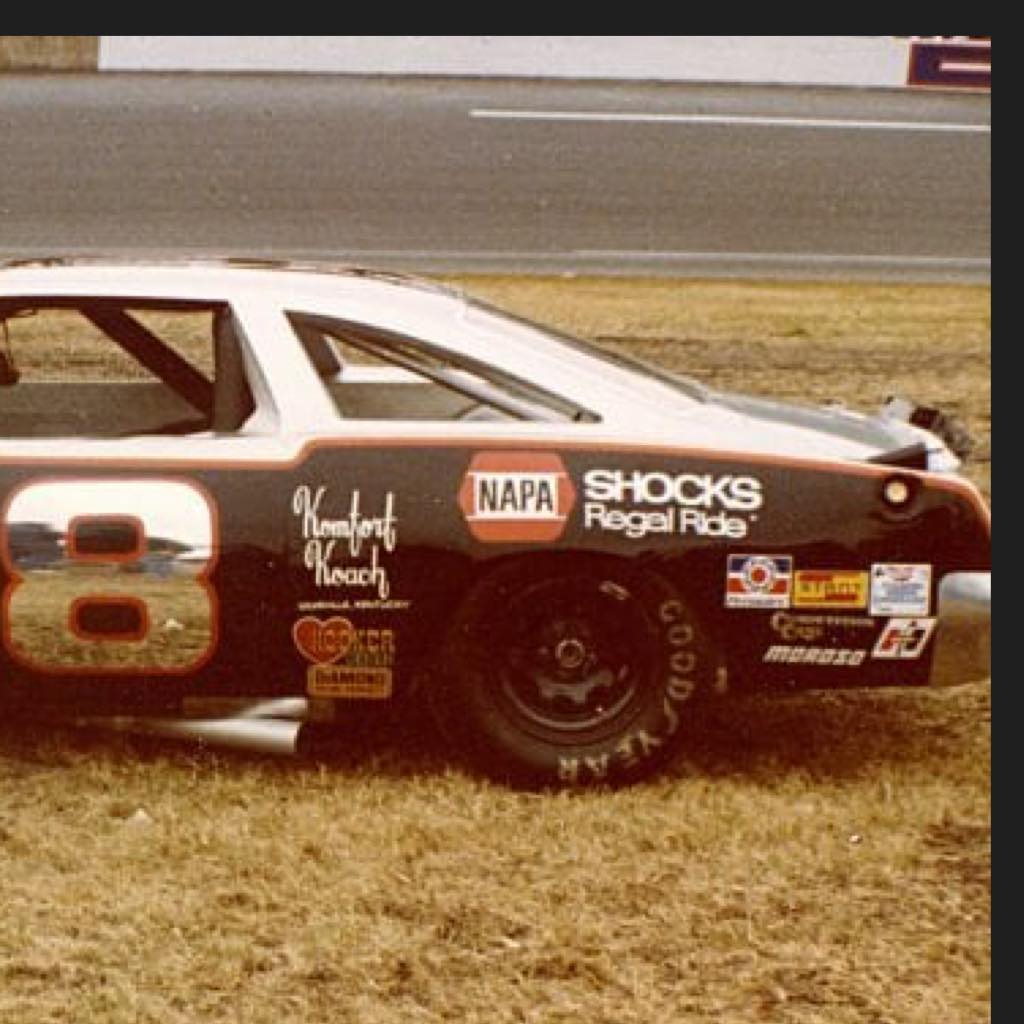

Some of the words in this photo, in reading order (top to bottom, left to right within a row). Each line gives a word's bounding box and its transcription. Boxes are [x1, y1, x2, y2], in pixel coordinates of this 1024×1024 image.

[479, 479, 554, 513] NAPA
[584, 469, 763, 512] SHOCKS
[293, 485, 398, 557] Komfort
[584, 502, 674, 539] Regal
[680, 508, 748, 539] Ride
[305, 539, 389, 600] Koach
